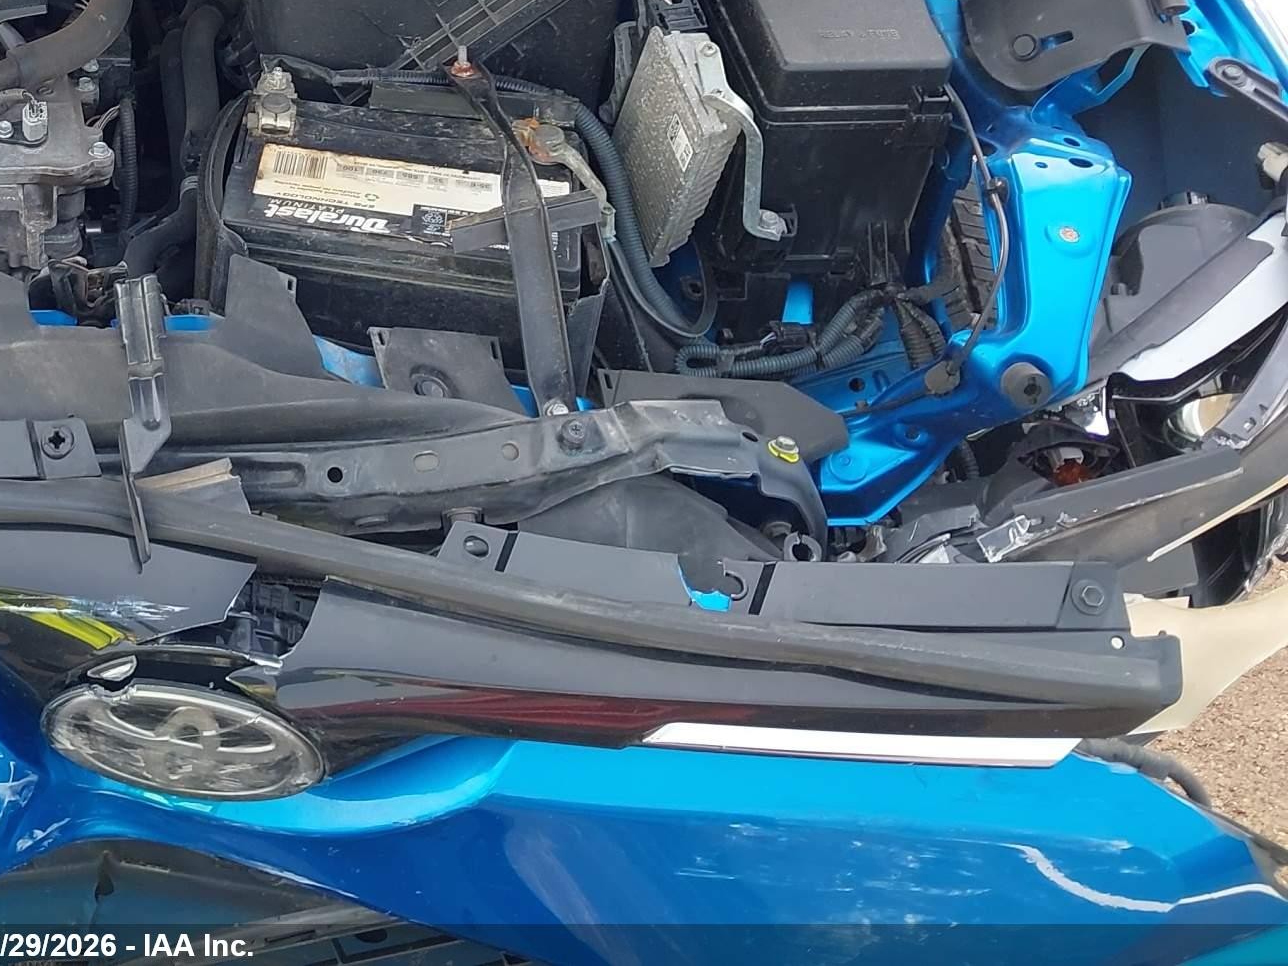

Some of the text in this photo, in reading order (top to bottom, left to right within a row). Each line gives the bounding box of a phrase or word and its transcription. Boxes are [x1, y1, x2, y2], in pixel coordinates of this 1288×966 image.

[268, 198, 345, 214] PLATINUM
[276, 192, 349, 205] TECHNOLOGY
[263, 203, 392, 234] Duralast
